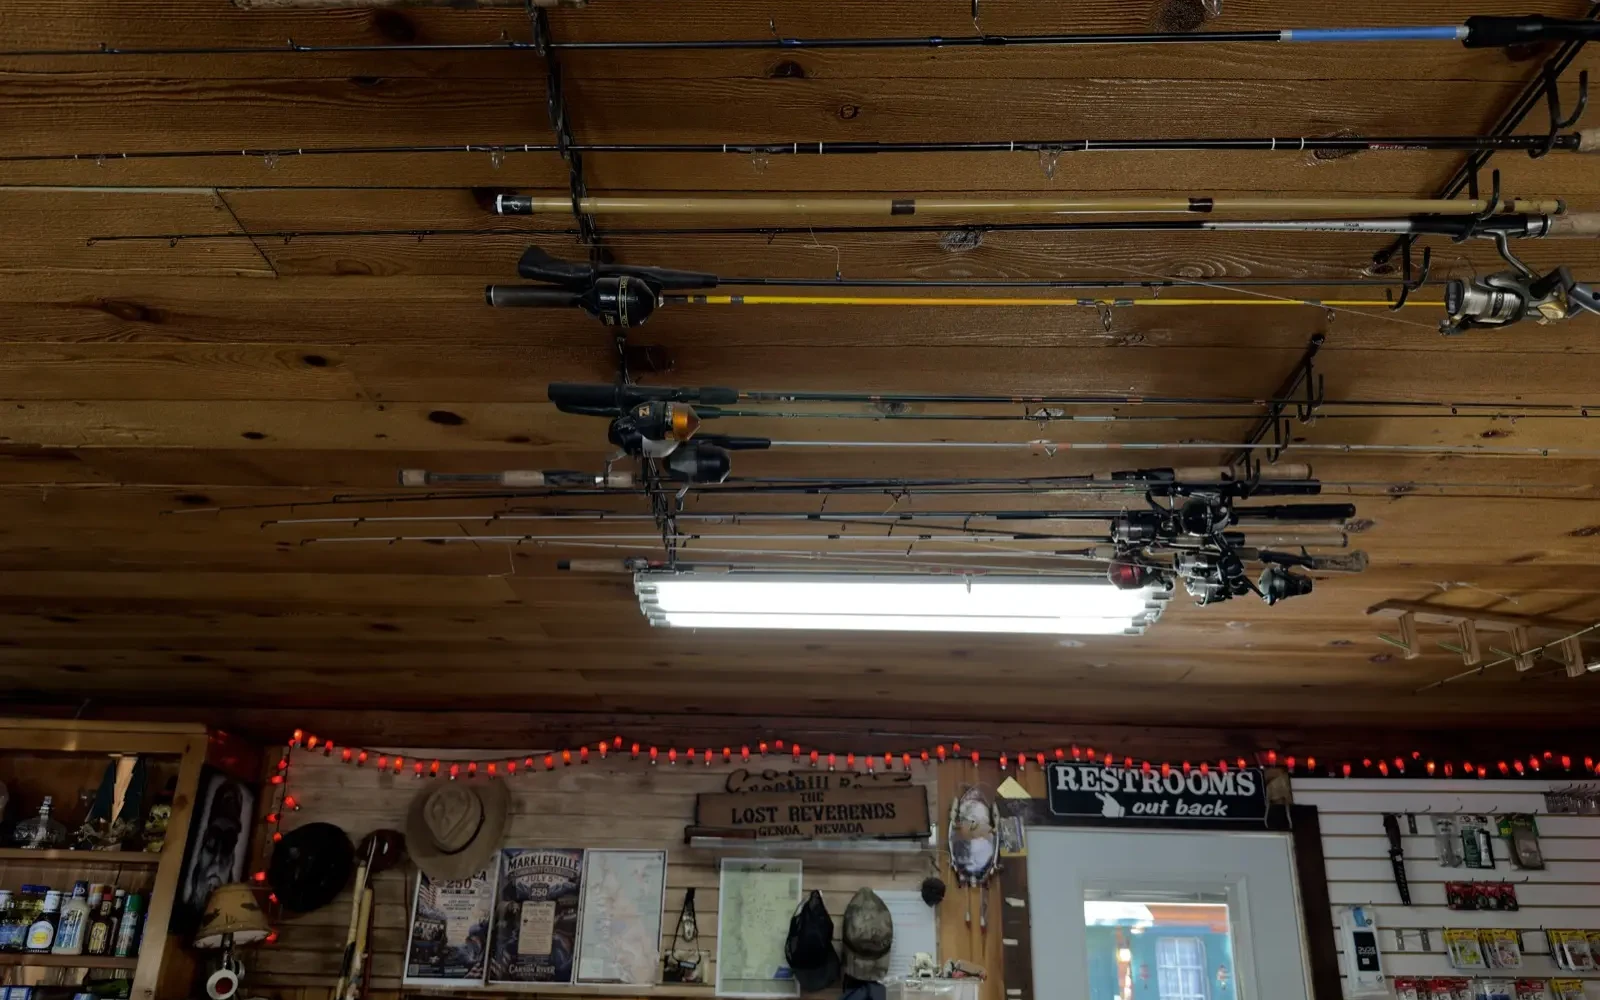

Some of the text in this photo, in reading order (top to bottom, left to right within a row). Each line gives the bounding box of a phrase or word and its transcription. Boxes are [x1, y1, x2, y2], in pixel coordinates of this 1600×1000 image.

[1055, 766, 1256, 797] RESTROOMS
[800, 791, 824, 803] THE
[731, 802, 896, 824] LOST REVERENDS
[1131, 798, 1229, 817] out back
[814, 823, 865, 835] NEVADA
[508, 854, 580, 872] MARKLEEVILLE
[525, 875, 545, 883] JULY
[531, 887, 548, 897] 250
